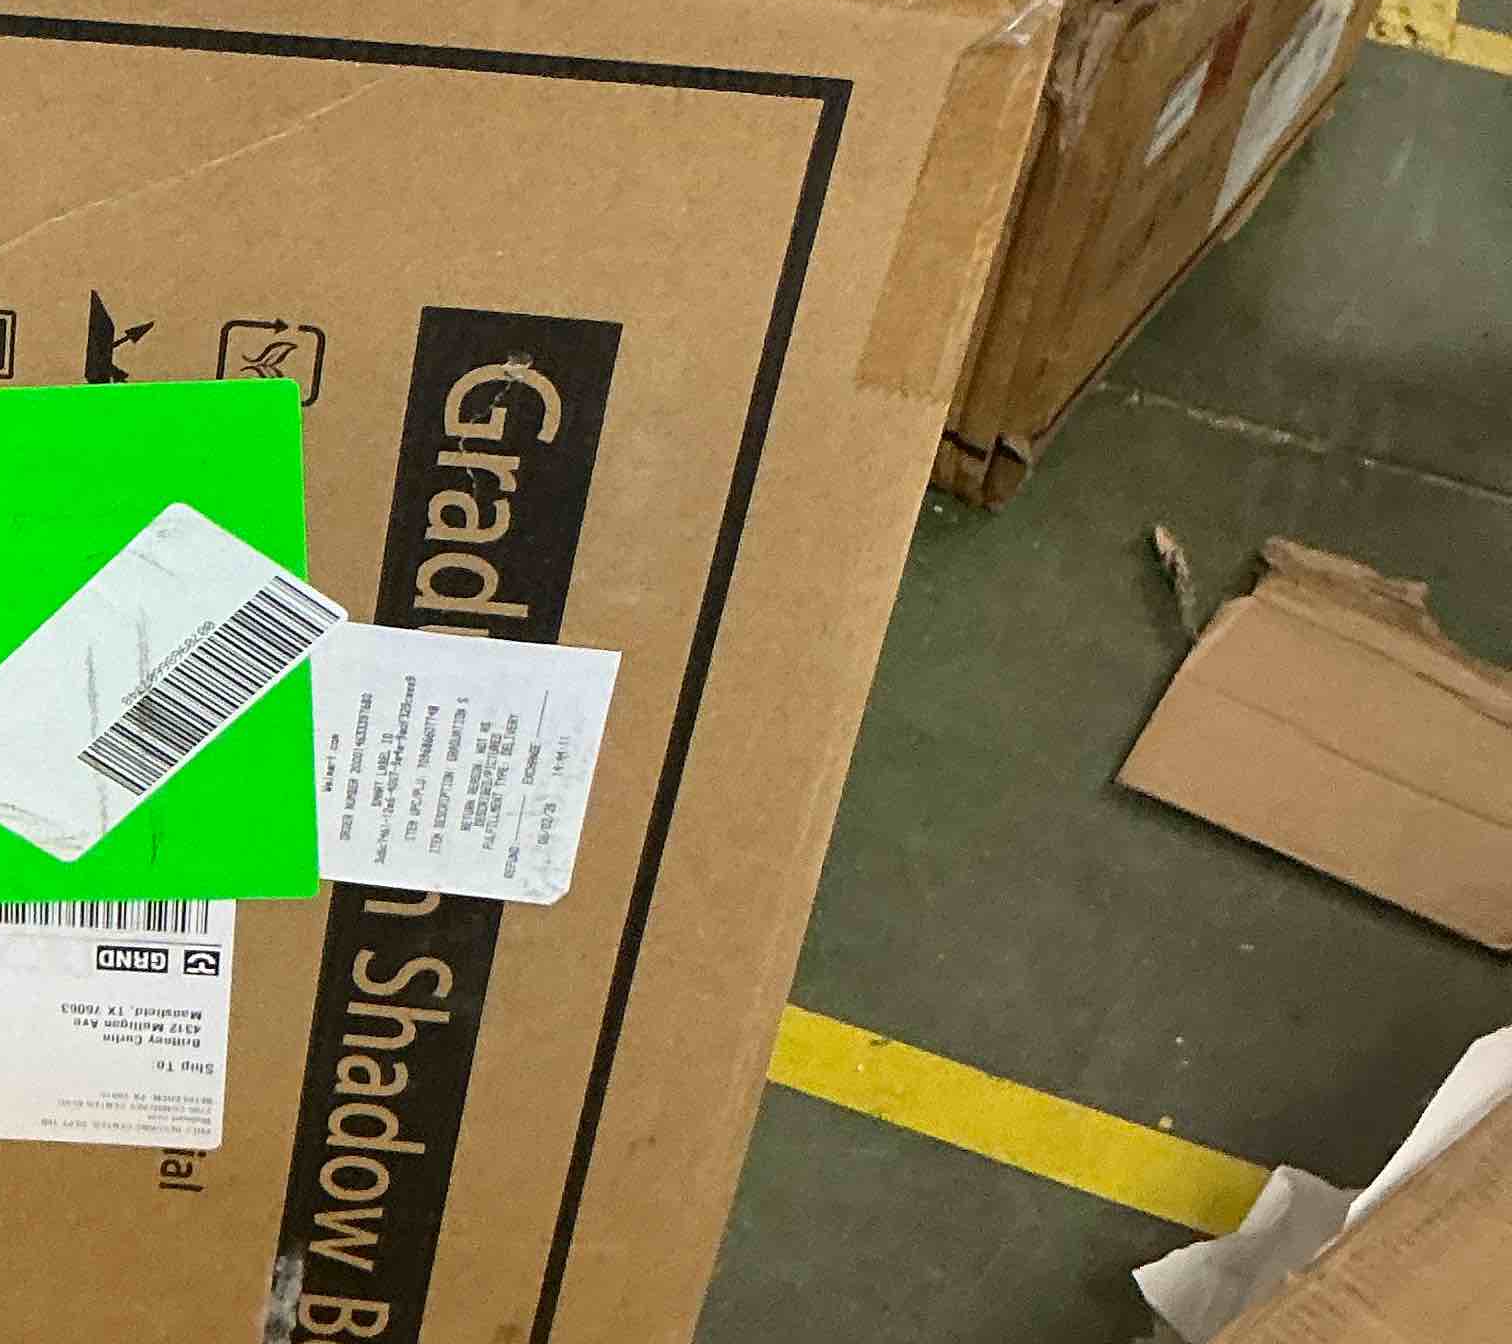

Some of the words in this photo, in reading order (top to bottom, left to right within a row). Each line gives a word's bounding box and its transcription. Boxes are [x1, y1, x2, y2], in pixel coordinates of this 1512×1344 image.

[500, 713, 520, 757] DELIVERY
[96, 946, 167, 972] GRND
[180, 1059, 214, 1075] Ship
[306, 948, 454, 1271] Shadow
[159, 1148, 206, 1192] ial
